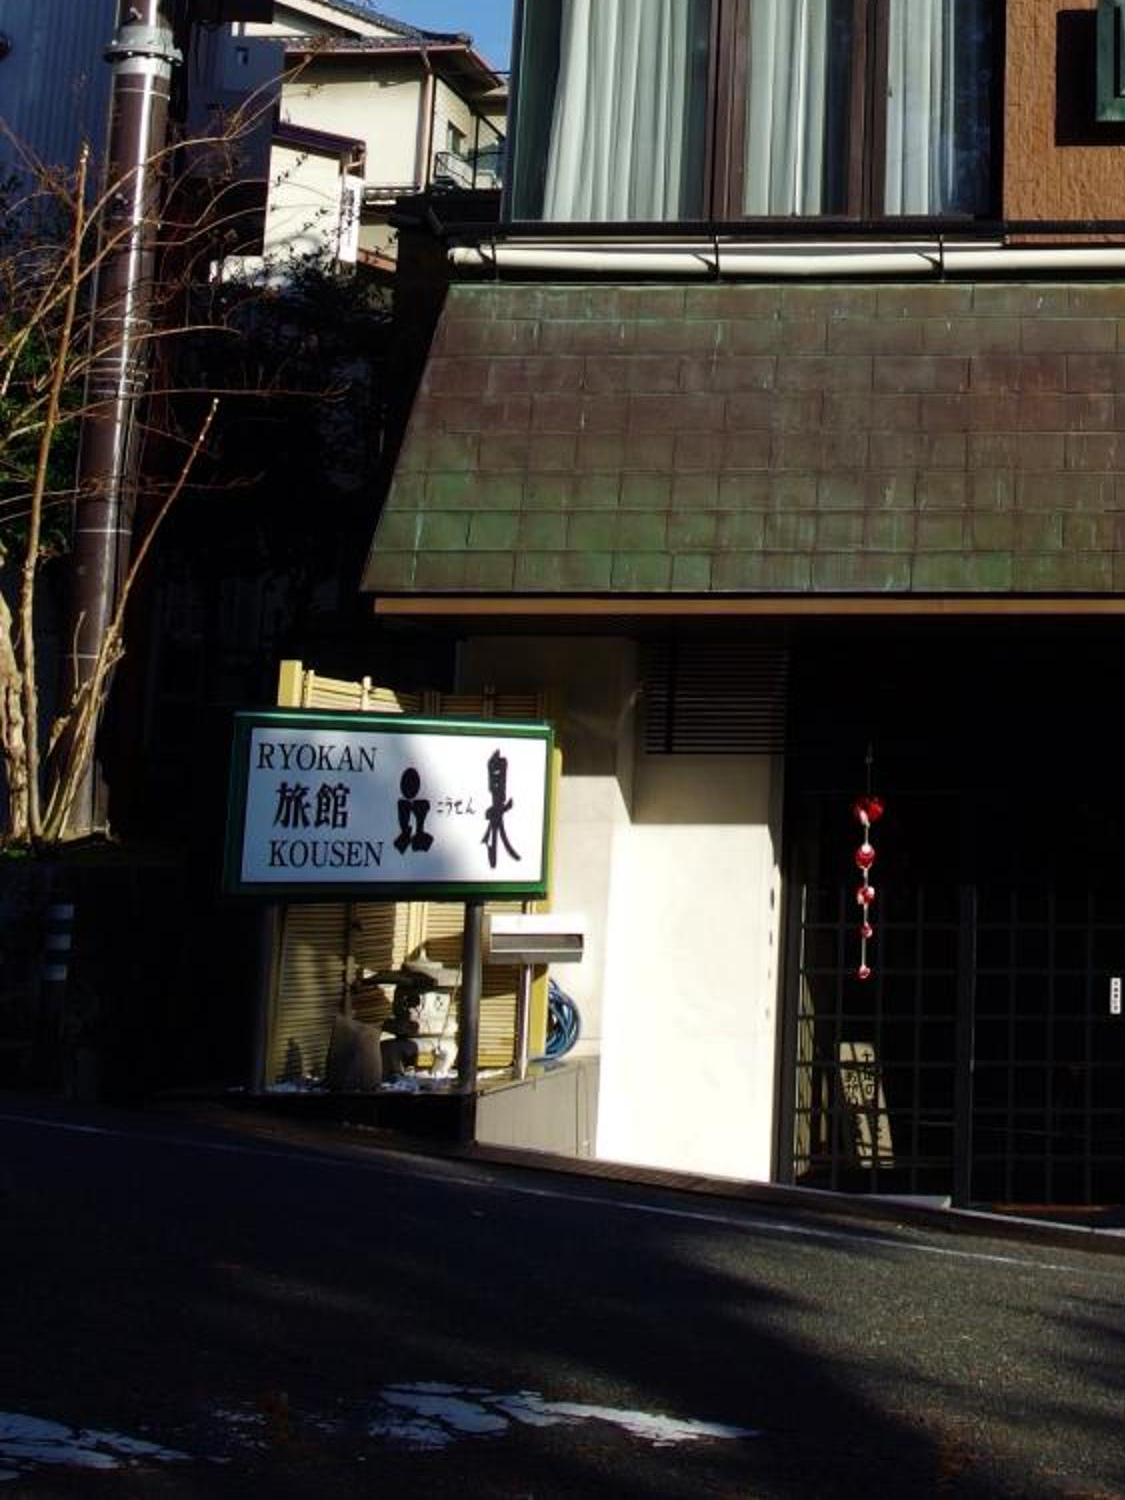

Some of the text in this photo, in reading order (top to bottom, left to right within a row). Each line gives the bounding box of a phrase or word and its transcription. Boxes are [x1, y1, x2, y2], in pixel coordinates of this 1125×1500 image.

[256, 742, 378, 772] RYOKAN
[273, 782, 351, 829] 旅館
[436, 797, 476, 816] こうせん
[268, 839, 385, 869] KOUSEN
